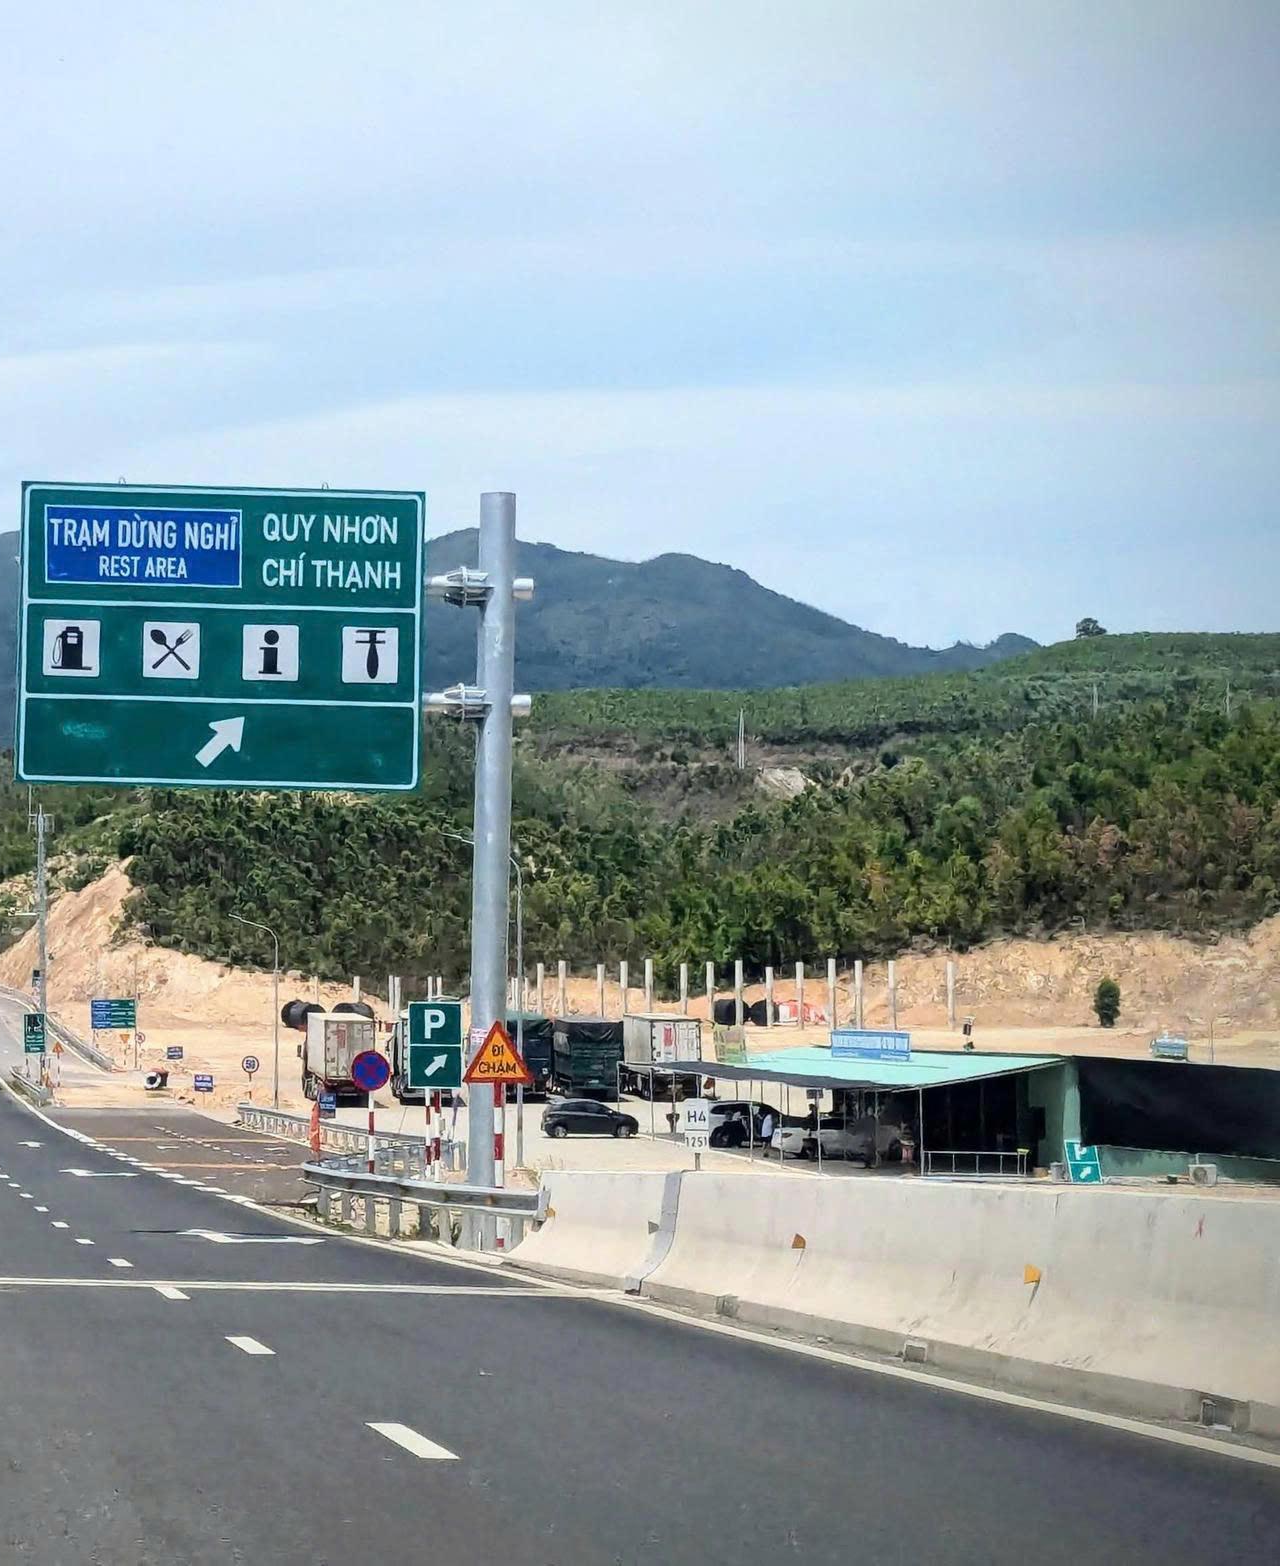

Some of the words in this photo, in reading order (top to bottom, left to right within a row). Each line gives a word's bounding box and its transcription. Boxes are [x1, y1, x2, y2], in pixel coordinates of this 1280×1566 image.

[49, 518, 110, 552] TRẠM
[117, 513, 178, 549] DỪNG
[184, 516, 239, 551] NGHỈ
[262, 512, 317, 542] QUY
[323, 513, 398, 545] NHƠN
[98, 555, 141, 577] REST
[144, 556, 188, 579] AREA
[262, 551, 307, 587] CHÍ
[311, 559, 401, 593] THẠNH
[424, 1009, 446, 1039] P
